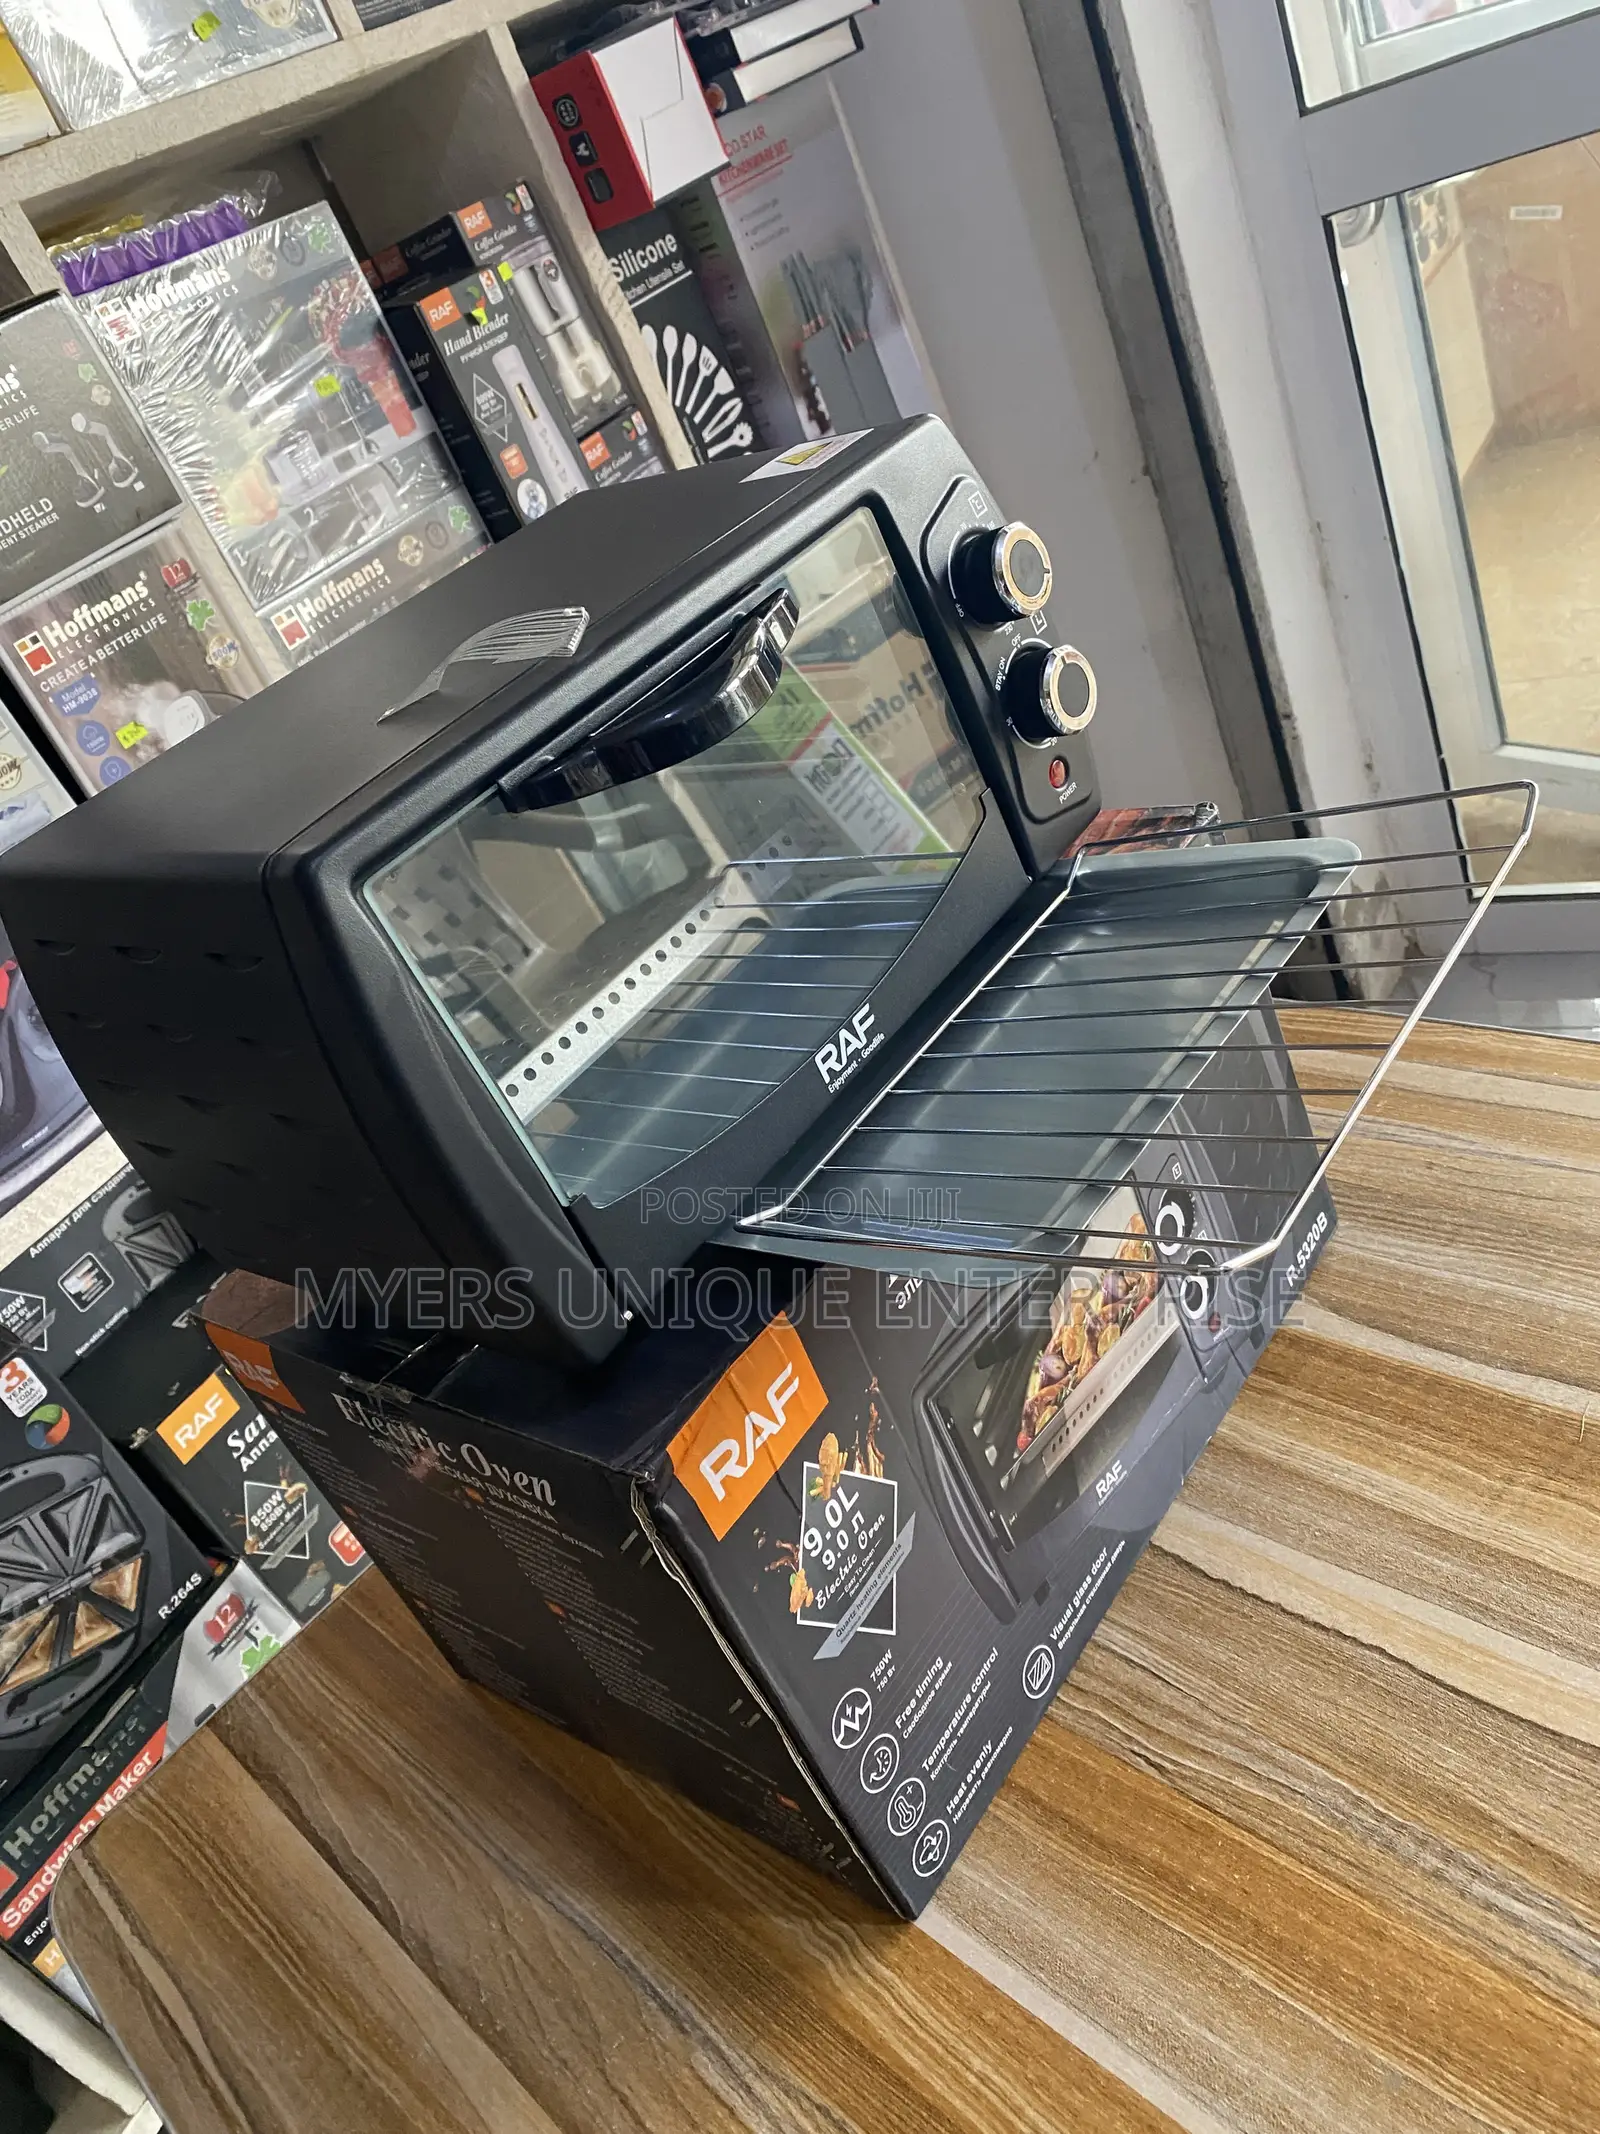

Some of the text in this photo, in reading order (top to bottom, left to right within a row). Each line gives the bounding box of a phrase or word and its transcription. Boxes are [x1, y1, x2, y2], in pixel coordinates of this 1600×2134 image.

[740, 124, 767, 150] STAR
[464, 211, 486, 230] RAF
[608, 233, 679, 283] Silicone
[429, 301, 454, 323] RAF
[443, 312, 510, 357] Hand Blender
[13, 404, 40, 426] LIFE
[586, 443, 606, 463] RAF
[19, 511, 60, 540] STEAMER
[167, 561, 183, 579] 12
[296, 557, 386, 623] Hoffmans
[42, 579, 149, 648] Hoffmans
[57, 597, 157, 661] ELECTRONICS
[39, 612, 168, 693] CREATE A BETTER LIFE
[1011, 632, 1022, 647] OFF
[61, 683, 87, 703] Model
[993, 668, 1005, 692] STAY
[1059, 782, 1079, 804] POWER
[814, 1003, 875, 1085] RAF
[827, 1032, 886, 1094] Enjoyment Goodlife
[29, 1219, 72, 1259] Аппарат
[71, 1201, 92, 1224] для
[1285, 1211, 1328, 1288] R.5320B
[0, 1361, 28, 1394] 3
[6, 1377, 35, 1402] YEARS
[15, 1386, 36, 1405] ГОДА
[174, 1392, 223, 1449] RAF
[699, 1361, 800, 1503] RAF
[459, 1442, 557, 1507] Oven
[1095, 1460, 1123, 1498] RAF
[250, 1490, 283, 1527] 850W
[803, 1485, 860, 1558] 9.0L
[814, 1553, 859, 1610] Electric
[857, 1513, 886, 1550] Oven
[821, 1529, 849, 1571] 9.0
[844, 1573, 857, 1594] Easy
[861, 1548, 877, 1568] Clean
[157, 1571, 203, 1621] R.264S
[834, 1610, 858, 1639] Quartz
[856, 1579, 879, 1610] heating
[876, 1543, 903, 1580] elements
[1049, 1546, 1108, 1642] Visual glass door
[215, 1603, 237, 1630] 12
[869, 1648, 894, 1683] 750W
[876, 1675, 891, 1693] 750
[895, 1656, 944, 1730] Free timing
[902, 1660, 953, 1740] Свободное время
[921, 1646, 999, 1772] Temperature control
[930, 1680, 992, 1782] Контроль температуры
[94, 1751, 153, 1818] Maker
[946, 1739, 993, 1815] Heat evenly
[952, 1725, 1013, 1825] Нагревать равномерно
